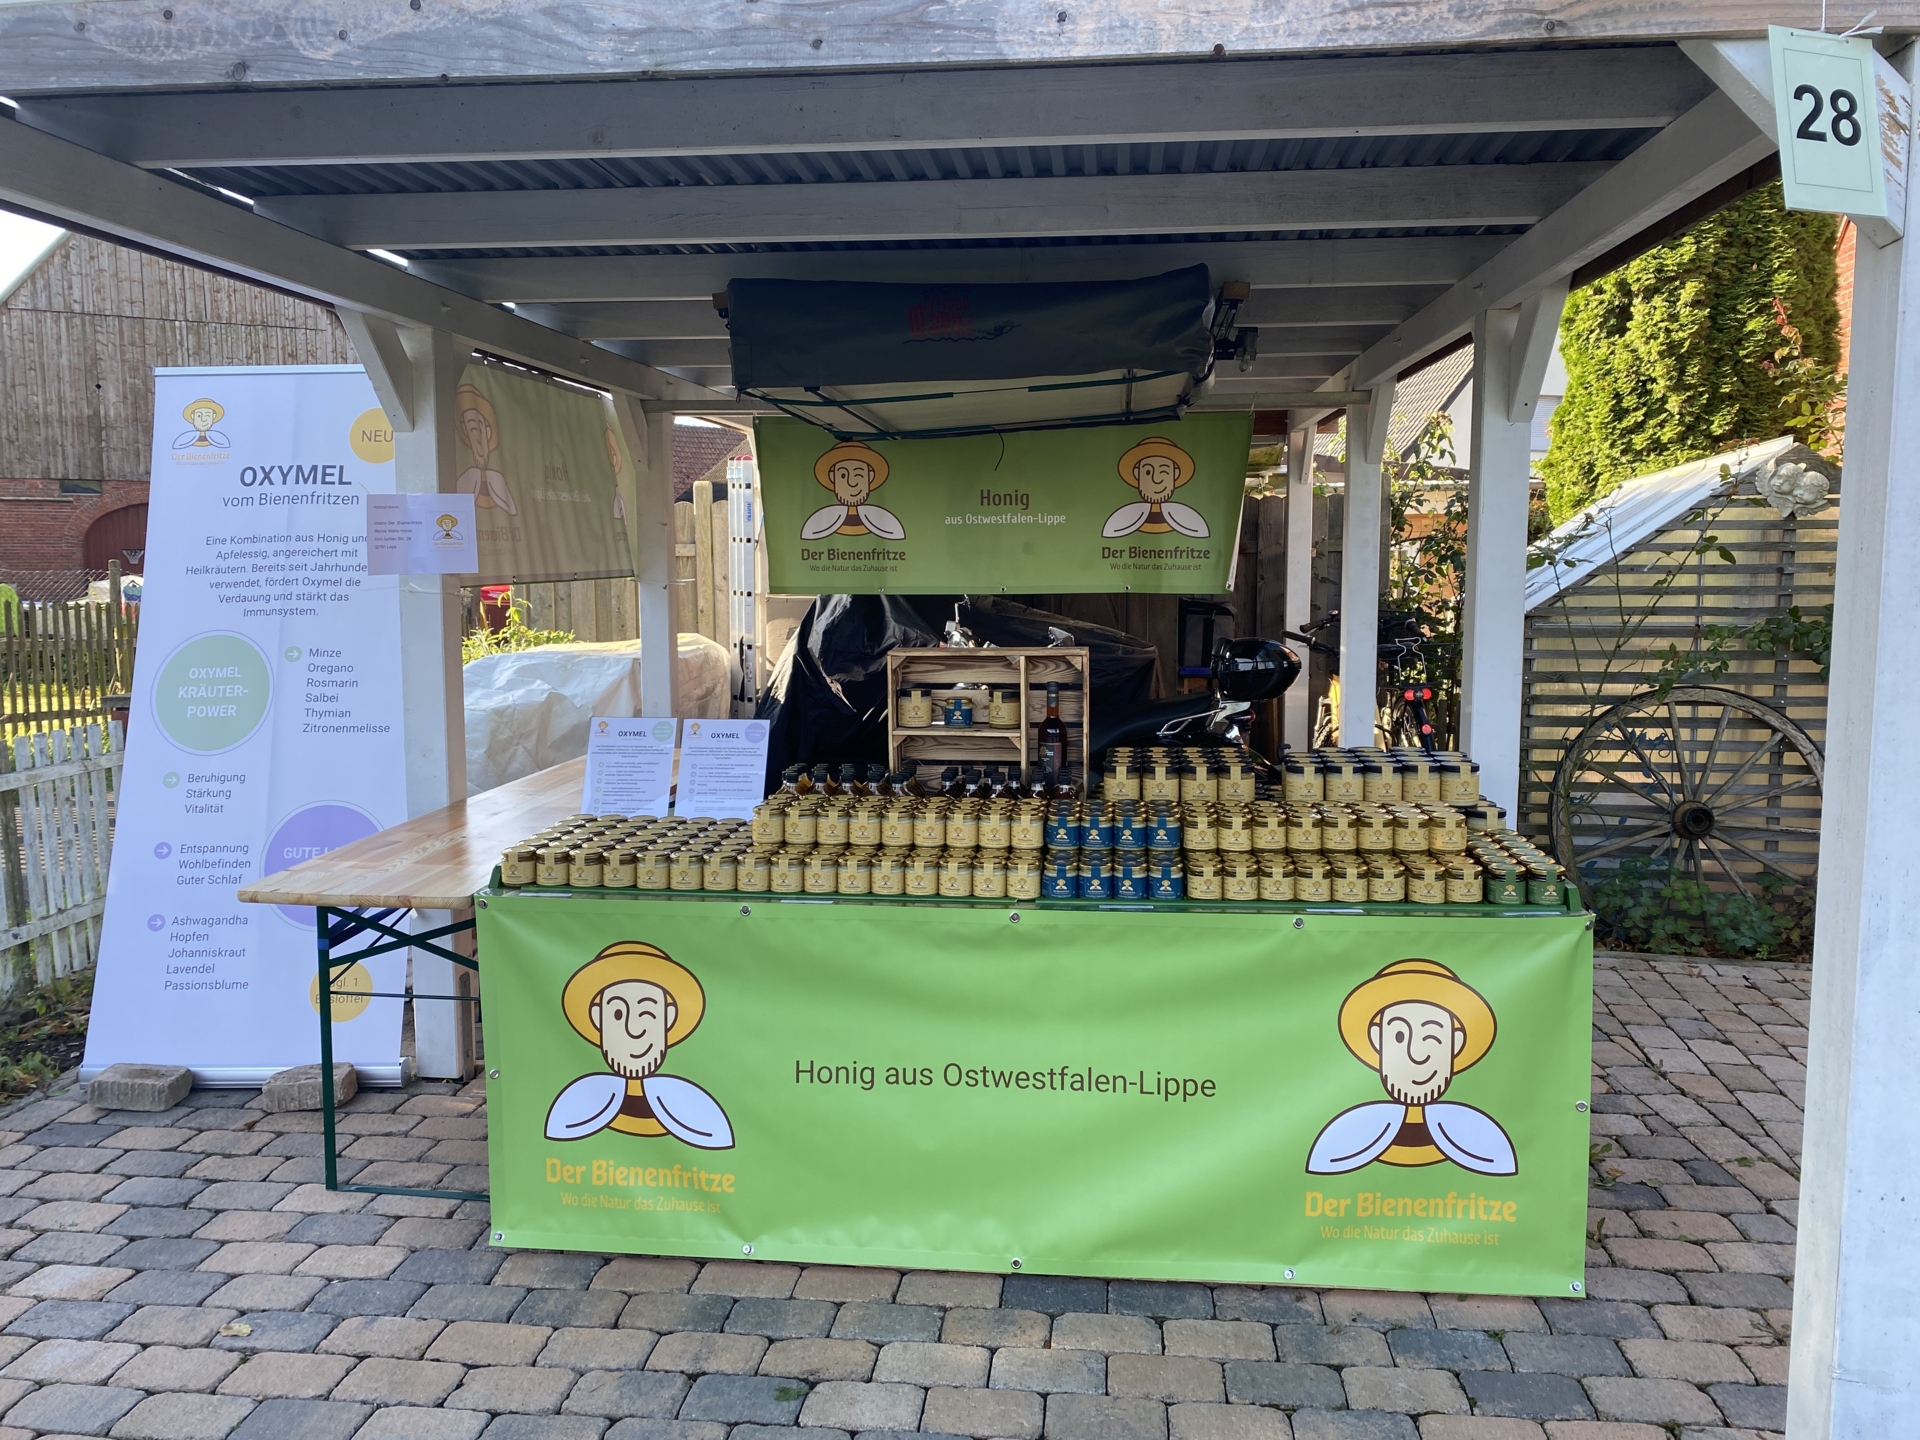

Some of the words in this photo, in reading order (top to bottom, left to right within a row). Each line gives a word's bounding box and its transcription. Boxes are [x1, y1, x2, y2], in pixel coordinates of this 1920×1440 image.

[1793, 84, 1862, 146] 28
[361, 429, 394, 443] NEU
[239, 464, 352, 487] OXYMEL
[222, 495, 255, 508] vom
[258, 491, 360, 507] Bienenfritzen
[979, 487, 1030, 511] Honig
[944, 514, 963, 526] aus
[965, 511, 1066, 527] Ostwestfalen-Lippe
[206, 535, 228, 546] Eine
[230, 532, 292, 546] Kombination
[294, 535, 314, 543] aus
[317, 533, 349, 545] Honig
[216, 548, 270, 561] Apfelessig,
[272, 547, 338, 559] angereichert
[341, 548, 359, 558] mit
[801, 548, 825, 561] Der
[827, 547, 907, 561] Bienenfritze
[1101, 546, 1125, 559] Der
[1128, 546, 1211, 559] Bienenfritze
[185, 563, 249, 576] Heilkräutern.
[251, 562, 287, 574] Bereits
[288, 562, 308, 572] seit
[310, 562, 368, 572] Jahrhunde
[809, 564, 821, 572] Wo
[821, 564, 831, 572] die
[831, 564, 850, 572] Natur
[851, 564, 862, 572] das
[863, 564, 888, 572] Zuhause
[889, 564, 898, 572] ist
[1110, 562, 1121, 570] Wo
[1122, 562, 1132, 570] die
[1132, 562, 1150, 570] Natur
[1151, 562, 1163, 570] das
[1163, 562, 1191, 571] Zuhause
[1193, 562, 1202, 571] ist
[209, 578, 262, 590] verwendet,
[265, 576, 300, 588] fördert
[302, 576, 342, 589] Oxymel
[345, 577, 361, 587] die
[218, 592, 271, 604] Verdauung
[273, 591, 293, 601] und
[295, 590, 327, 601] stärkt
[330, 591, 350, 601] das
[243, 606, 319, 618] Immunsystem.
[308, 647, 342, 658] Minze
[188, 666, 242, 679] OXYMEL
[307, 662, 354, 675] Oregano
[306, 677, 359, 688] Rosmarin
[178, 683, 249, 699] KRÄUTER-
[304, 692, 339, 703] Salbei
[186, 704, 237, 718] POWER
[304, 707, 352, 720] Thymian
[302, 722, 391, 734] Zitronenmelisse
[187, 772, 246, 785] Beruhigung
[185, 788, 232, 800] Stärkung
[184, 803, 224, 814] Vitalität
[179, 842, 249, 855] Entspannung
[283, 847, 321, 859] GUTE
[178, 858, 251, 870] Wohlbefinden
[176, 874, 206, 886] Guter
[207, 873, 243, 885] Schlaf
[171, 915, 249, 927] Ashwagandha
[170, 931, 209, 943] Hopfen
[167, 946, 246, 958] Johanniskraut
[166, 963, 215, 974] Lavendel
[164, 979, 249, 991] Passionsblume
[353, 977, 358, 988] 1
[795, 1060, 875, 1091] Honig
[884, 1067, 934, 1086] aus
[943, 1062, 1217, 1103] Ostwestfalen-Lippe
[545, 1157, 587, 1185] Der
[591, 1159, 735, 1193] Bienenfritze
[560, 1192, 579, 1206] Wo
[581, 1193, 598, 1208] die
[600, 1195, 631, 1210] Natur
[634, 1196, 654, 1211] das
[656, 1197, 705, 1213] Zuhause
[707, 1200, 721, 1214] ist
[1304, 1191, 1351, 1218] Der
[1356, 1191, 1517, 1222] Bienenfritze
[1320, 1226, 1340, 1239] Wo
[1342, 1225, 1361, 1239] die
[1363, 1225, 1400, 1240] Natur
[1402, 1226, 1425, 1242] das
[1426, 1227, 1480, 1245] Zuhause
[1483, 1231, 1500, 1246] ist
